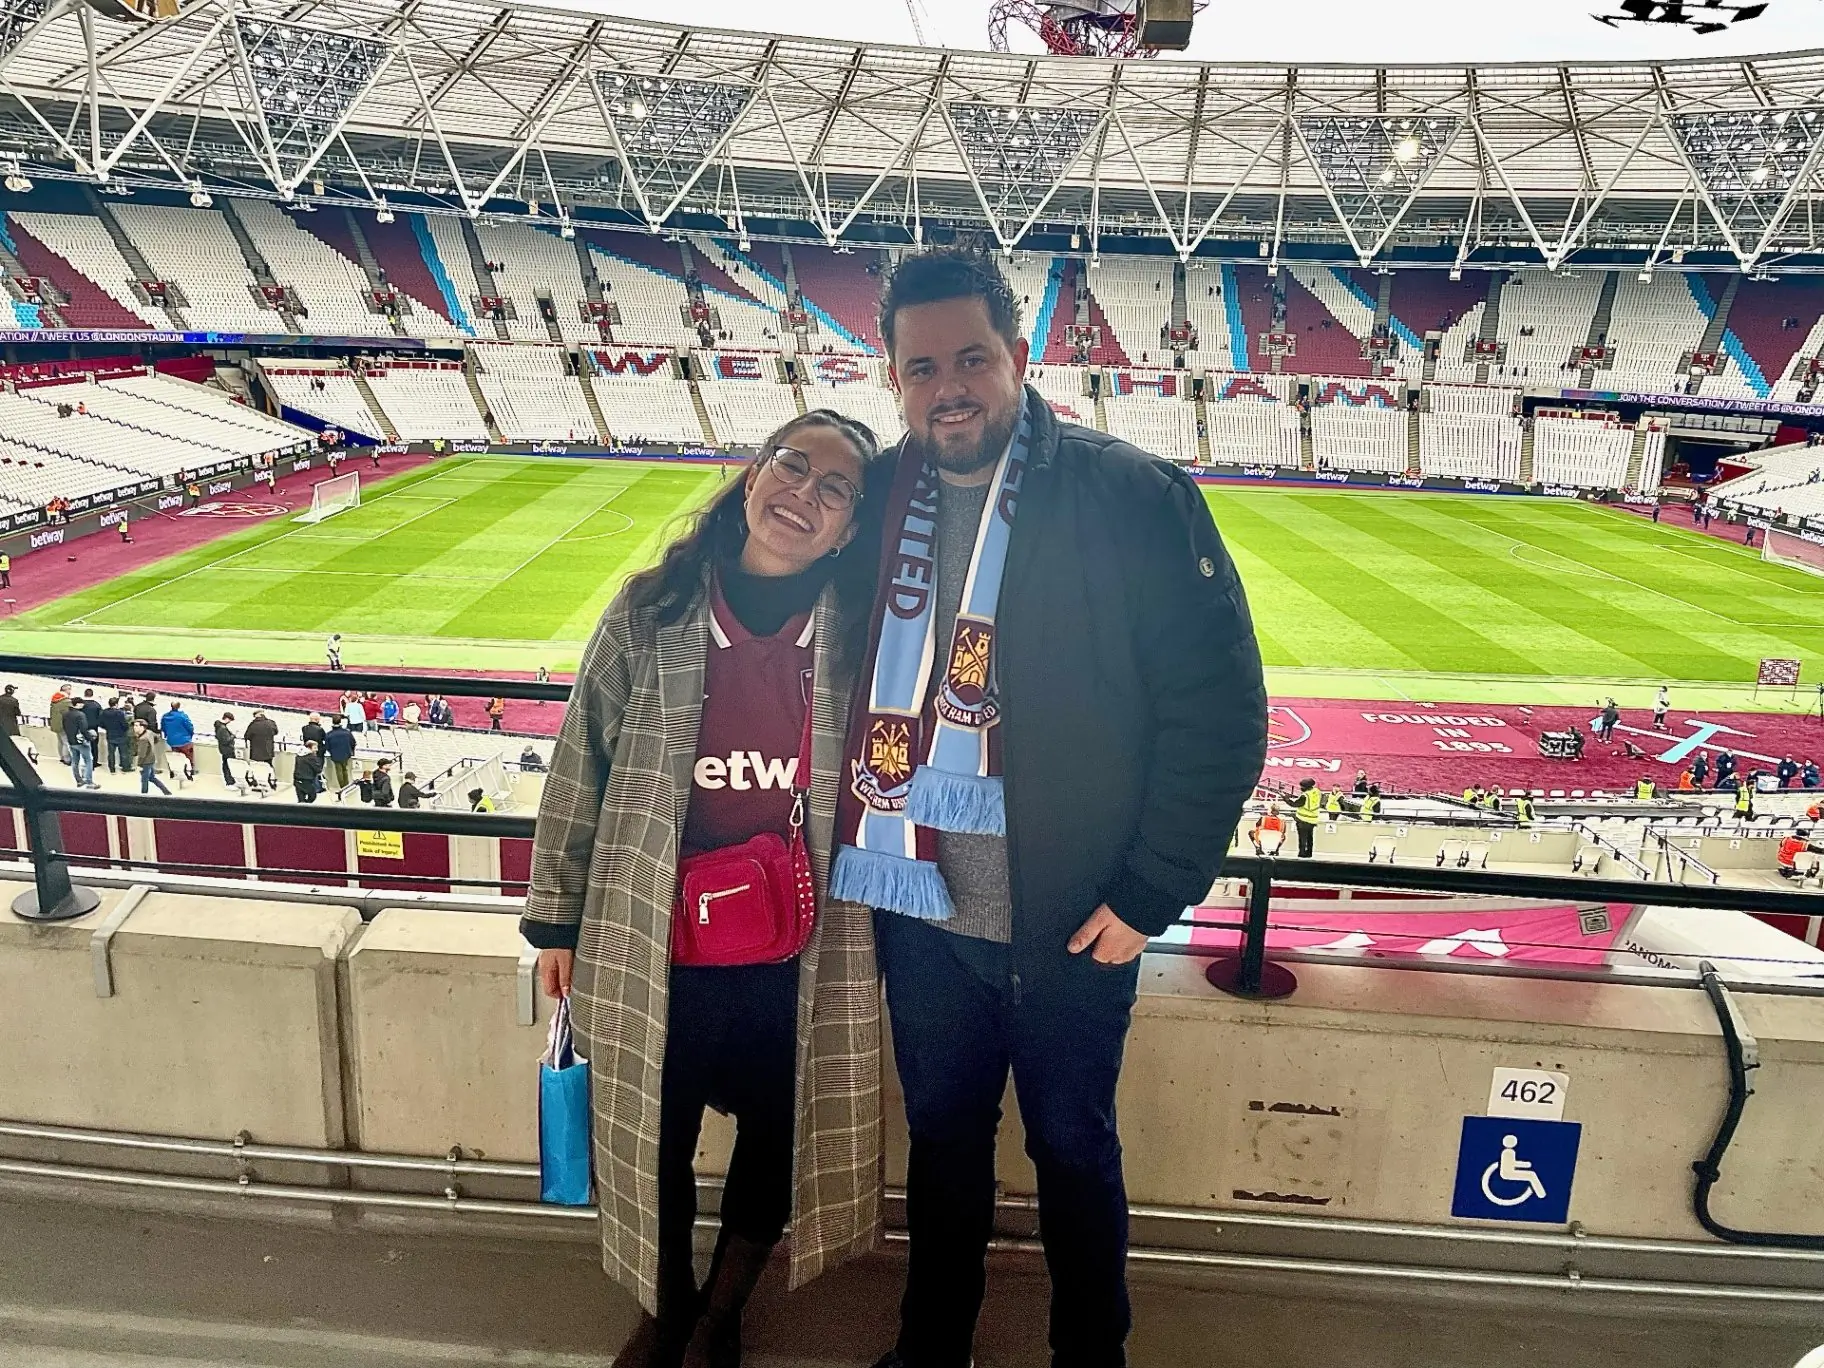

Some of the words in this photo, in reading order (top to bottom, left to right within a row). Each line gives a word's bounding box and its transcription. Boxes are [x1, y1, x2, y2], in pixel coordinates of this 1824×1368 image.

[0, 331, 29, 342] ATION
[41, 332, 73, 342] TWEET
[76, 332, 90, 342] US
[91, 332, 184, 342] @LONDONSTADIUM
[1617, 393, 1638, 403] JOIN
[1639, 394, 1656, 404] THE
[1657, 396, 1725, 409] CONVERSATION
[1736, 401, 1766, 412] TWEET
[1767, 403, 1780, 412] US
[452, 443, 490, 454] betway
[684, 446, 716, 457] betway
[1315, 470, 1349, 483] betway
[1389, 476, 1424, 488] beway
[1465, 479, 1500, 493] betway
[1543, 485, 1580, 499] betway
[158, 494, 184, 510] betway
[14, 511, 39, 525] betway
[30, 528, 65, 548] betway
[1360, 712, 1506, 728] FOUNDED
[1433, 727, 1472, 739] IN
[1432, 740, 1513, 753] 1895
[693, 750, 800, 791] etw
[1500, 1079, 1555, 1106] 462
